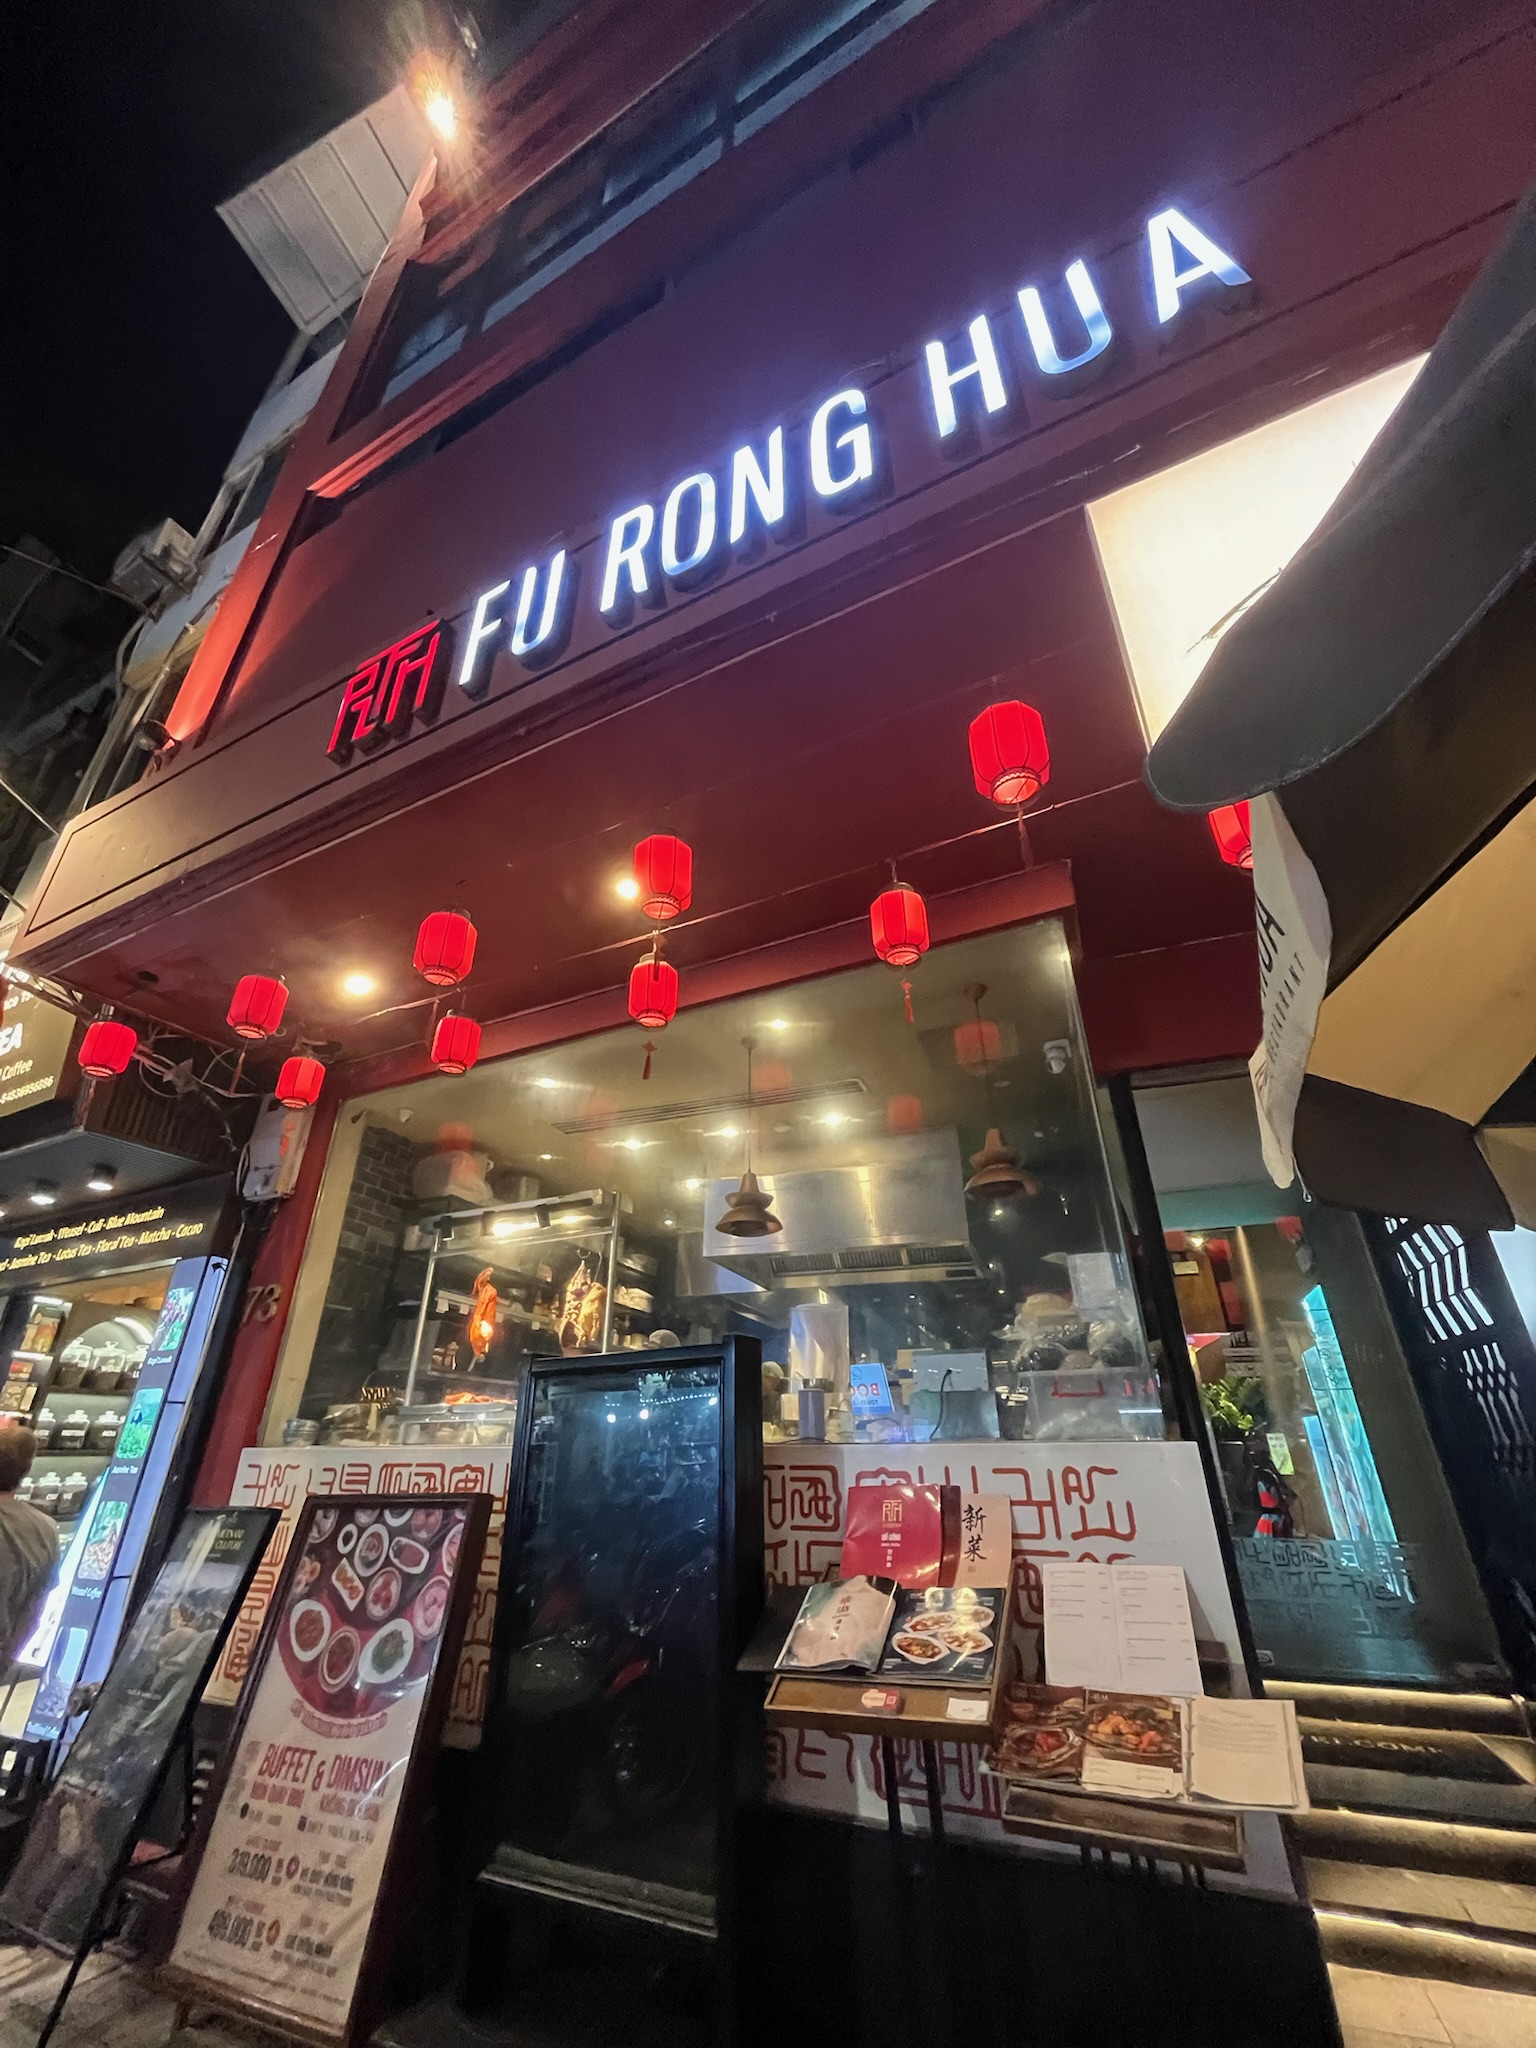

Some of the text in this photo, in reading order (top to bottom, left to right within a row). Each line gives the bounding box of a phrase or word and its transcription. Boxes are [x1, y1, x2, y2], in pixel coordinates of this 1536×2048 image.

[458, 548, 568, 688] FU
[599, 387, 874, 614] RONG
[924, 206, 1253, 439] HUA
[1, 1059, 33, 1081] Coffee
[8, 1253, 38, 1271] Jasmine
[37, 1251, 53, 1264] Tea
[55, 1246, 77, 1262] Lotus
[77, 1243, 92, 1257] Tea
[95, 1236, 120, 1254] Floral
[119, 1234, 135, 1249] Tea
[137, 1226, 172, 1246] Matcha
[175, 1222, 204, 1240] Cacao
[57, 1222, 86, 1240] Weasel
[105, 1213, 125, 1230] Blue
[124, 1205, 165, 1226] Mountain
[242, 1283, 282, 1323] 73
[961, 1503, 987, 1562] 新菜
[258, 1743, 393, 1798] BUFFET & DIMSUM
